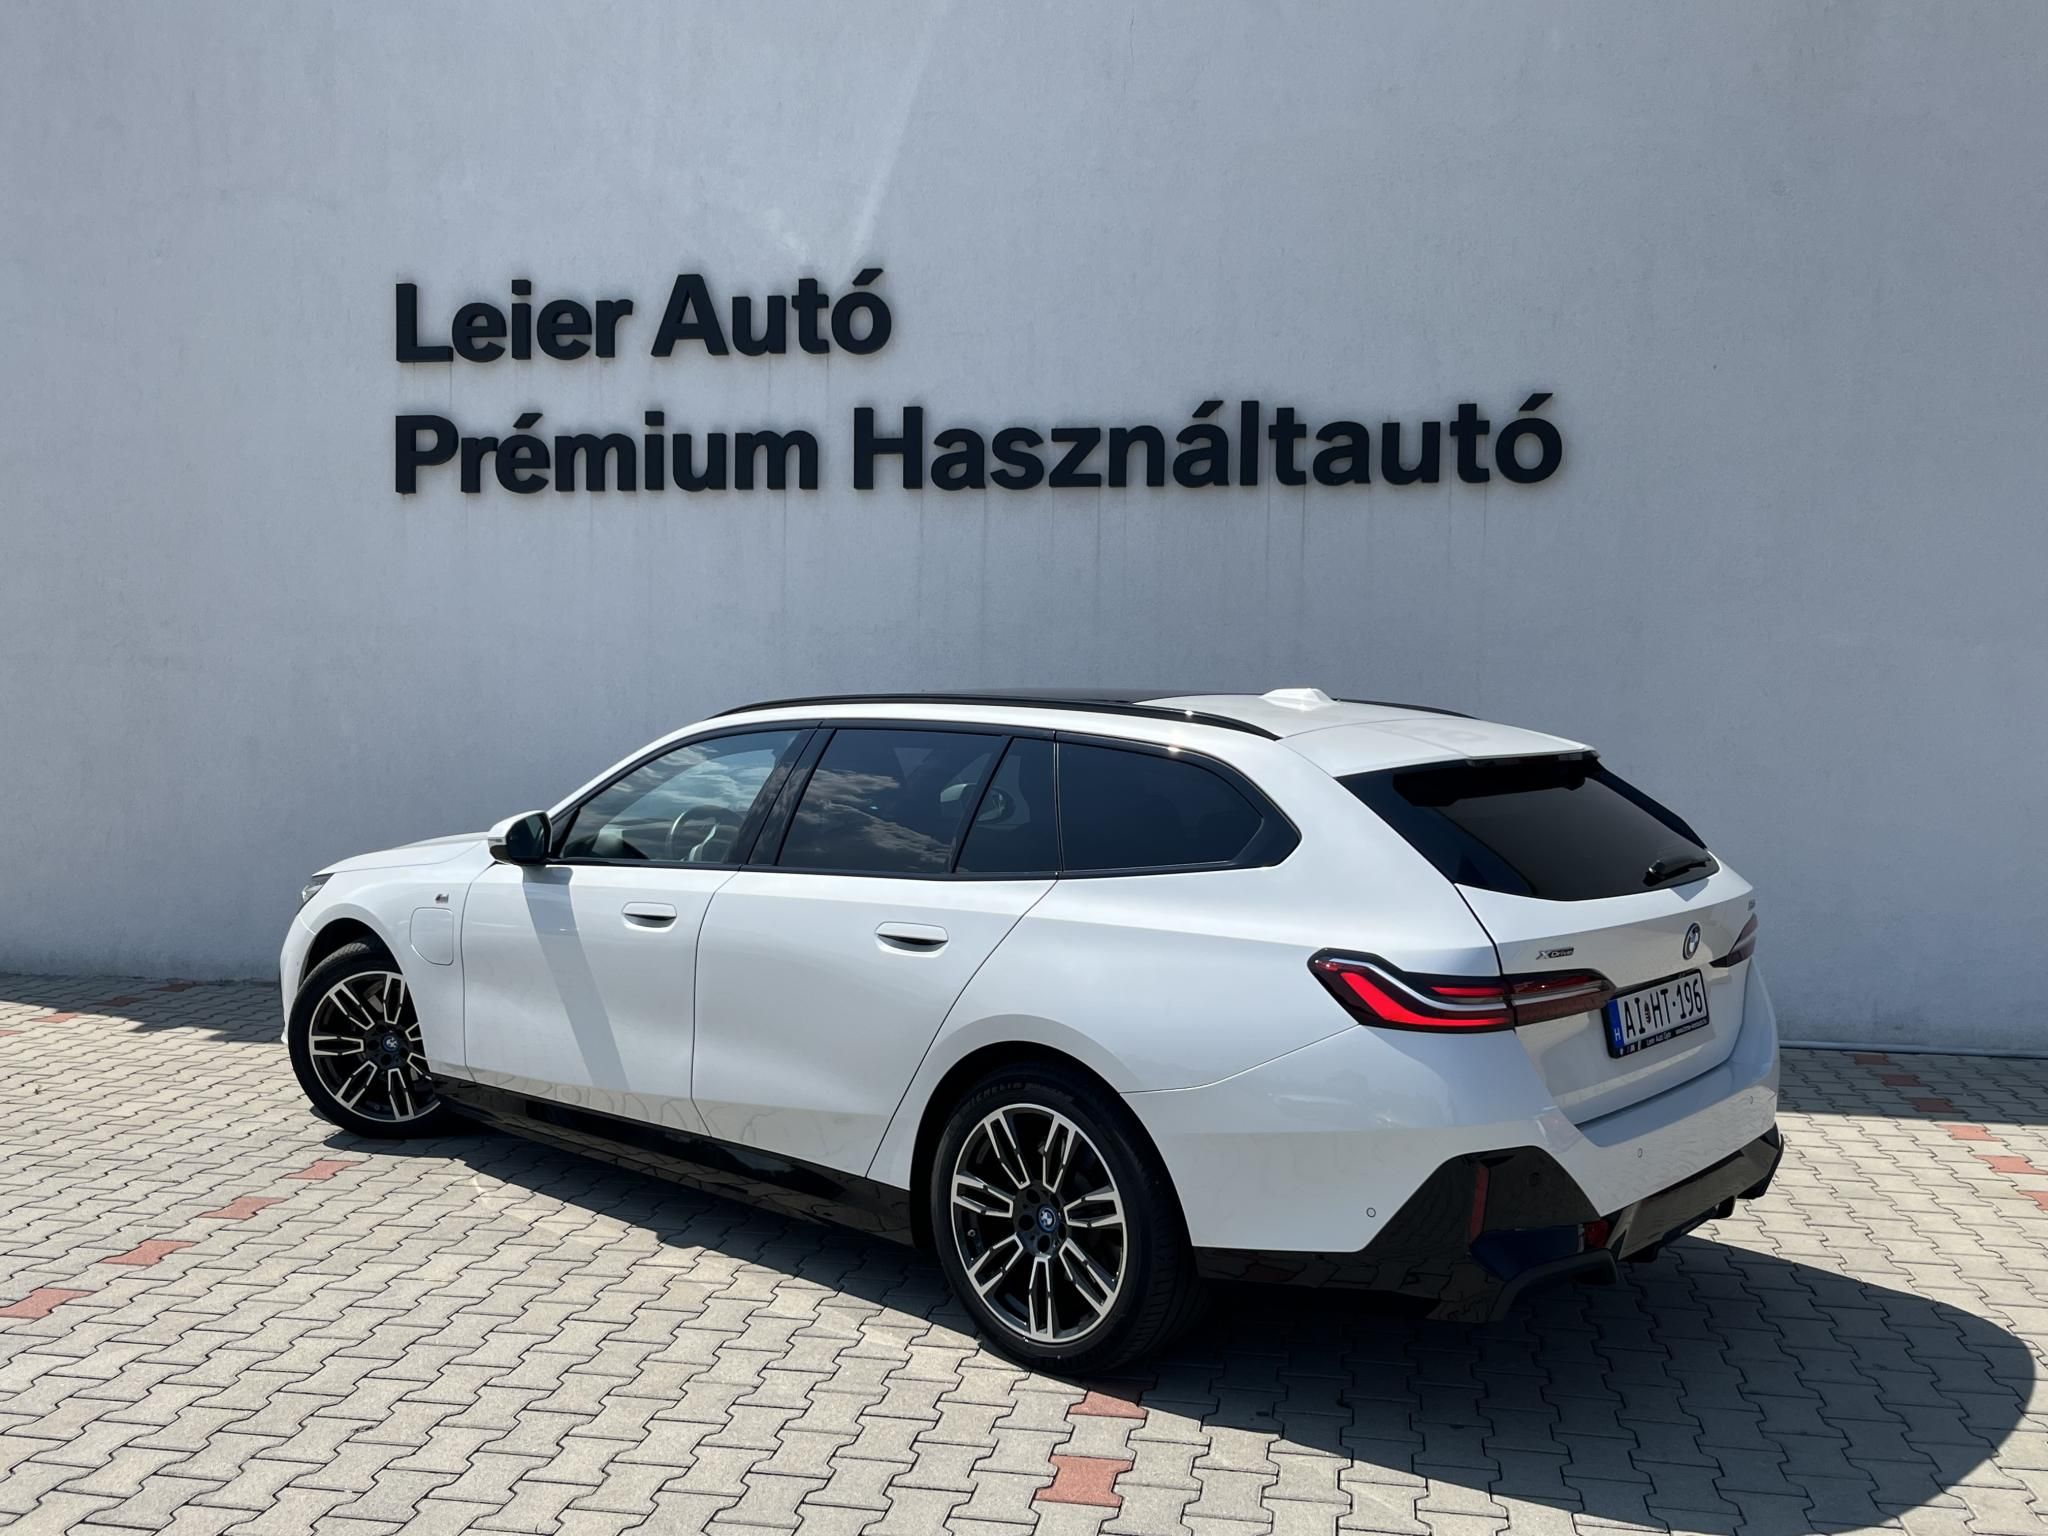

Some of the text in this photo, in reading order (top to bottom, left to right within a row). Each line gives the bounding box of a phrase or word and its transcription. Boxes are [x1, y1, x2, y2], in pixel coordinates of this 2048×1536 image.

[396, 268, 892, 363] Leier Autó
[396, 393, 1562, 495] Prémium Használtautó
[1614, 1028, 1621, 1042] H
[1624, 998, 1645, 1038] AI
